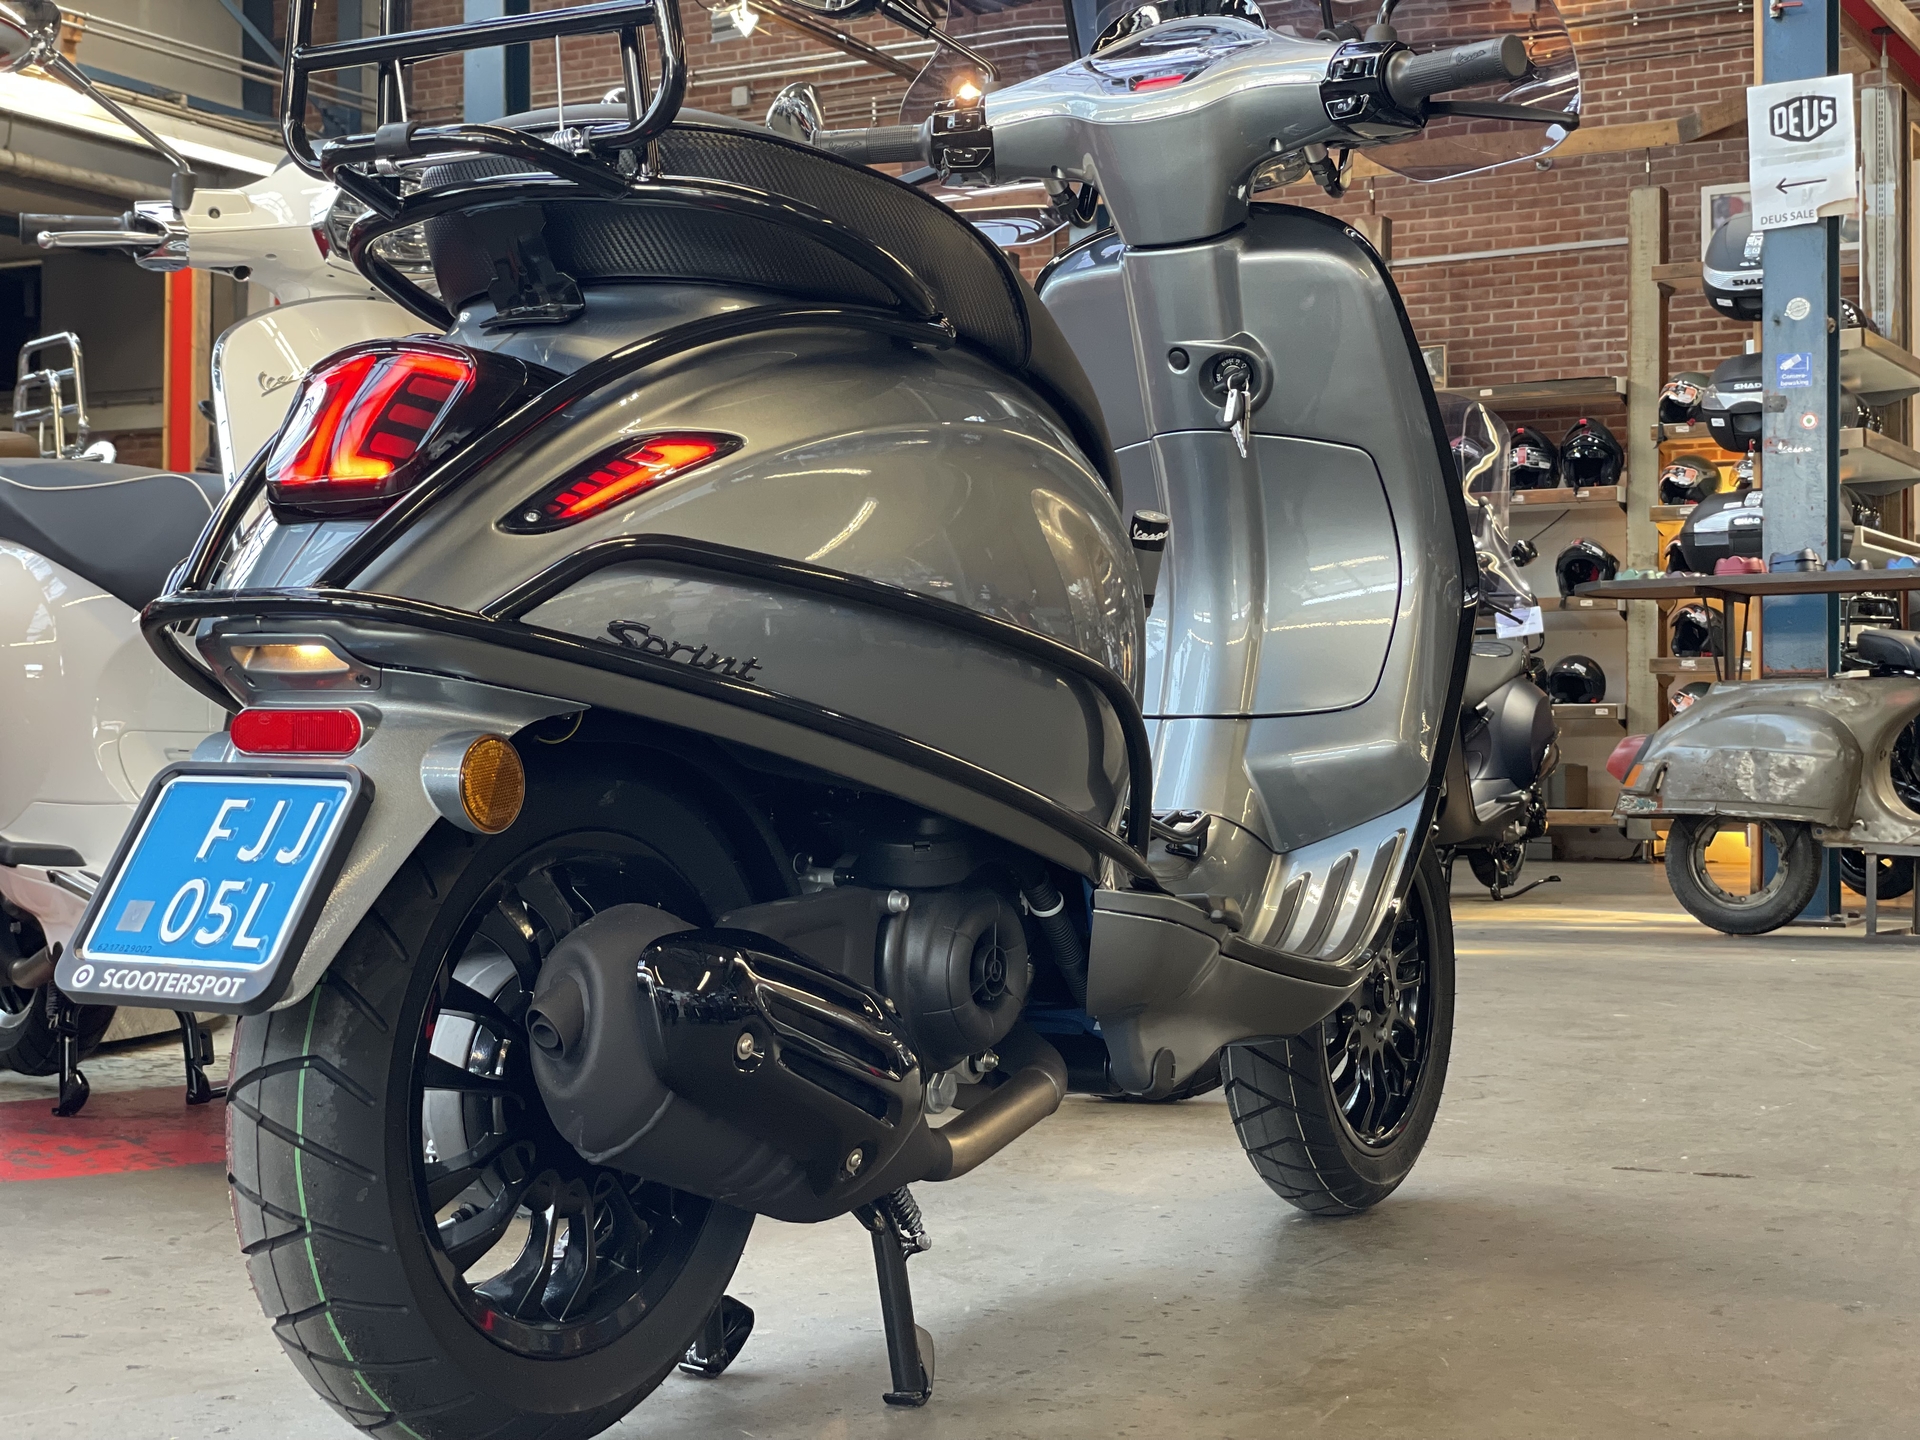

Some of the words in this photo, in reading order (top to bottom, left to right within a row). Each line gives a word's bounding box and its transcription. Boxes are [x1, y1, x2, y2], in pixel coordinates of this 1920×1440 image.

[1773, 98, 1834, 138] DEUS
[1760, 213, 1788, 226] DEUS
[1790, 209, 1815, 221] SALE
[596, 620, 763, 682] Sprint
[196, 798, 327, 864] FJJ
[160, 878, 269, 949] 05L
[99, 967, 246, 998] SCOOTERSPOT
